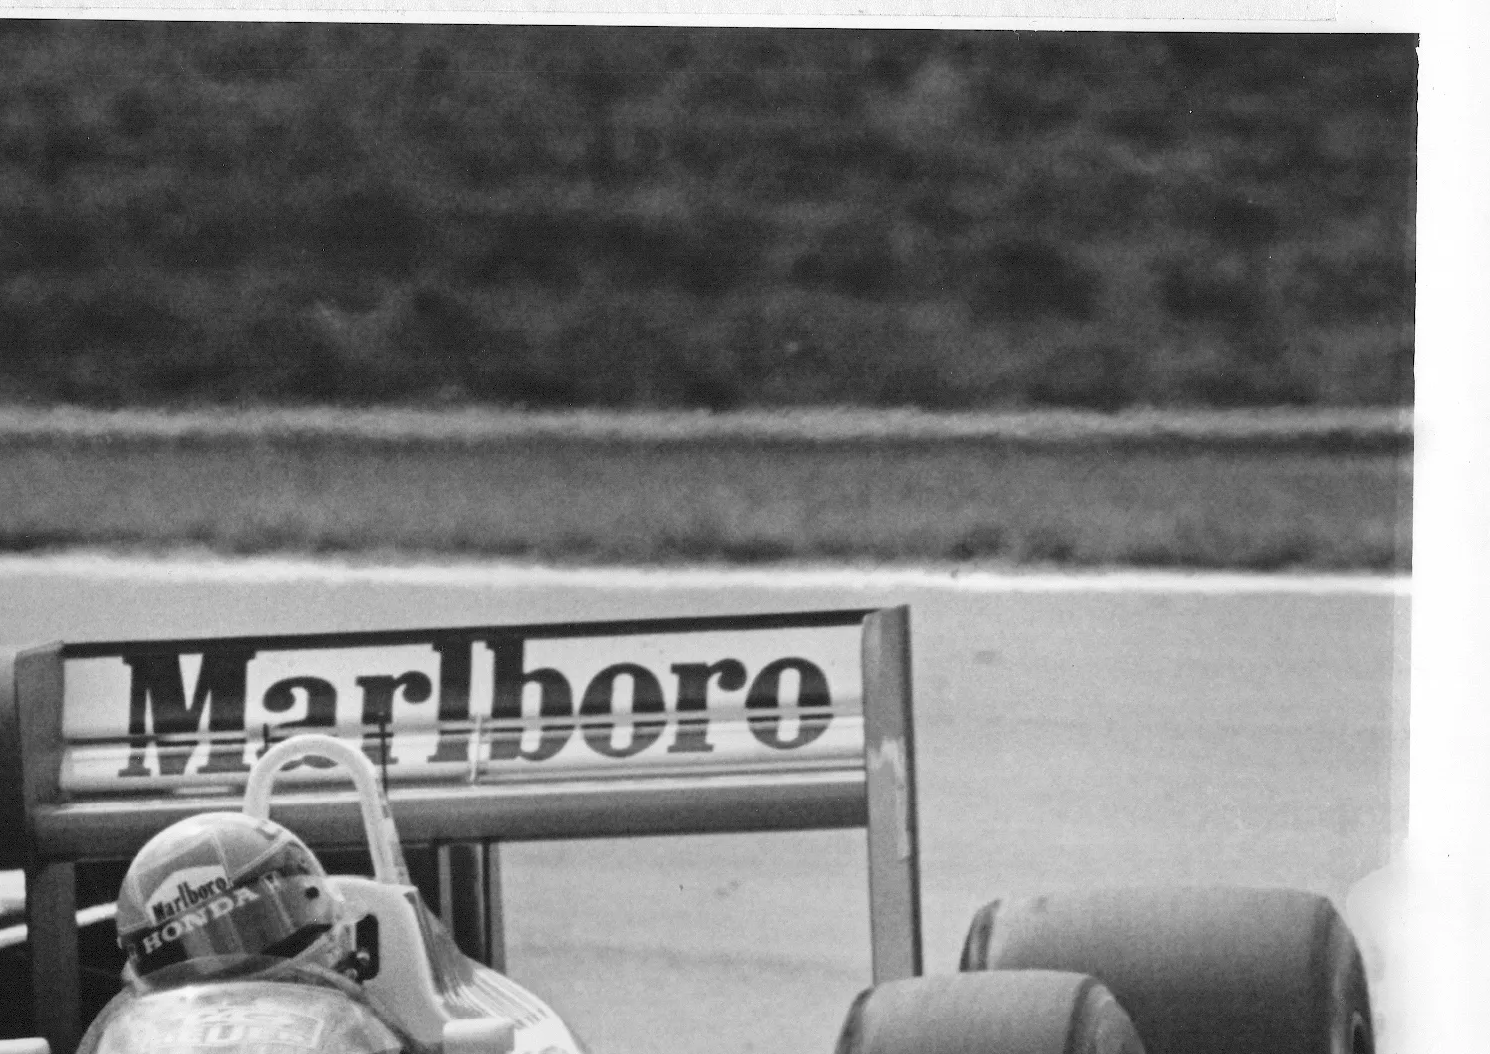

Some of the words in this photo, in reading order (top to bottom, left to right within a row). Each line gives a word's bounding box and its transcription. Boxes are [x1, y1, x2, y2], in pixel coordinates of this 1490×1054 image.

[118, 636, 833, 777] Marlboro
[142, 886, 261, 954] HONDA
[151, 876, 228, 921] Marlboro
